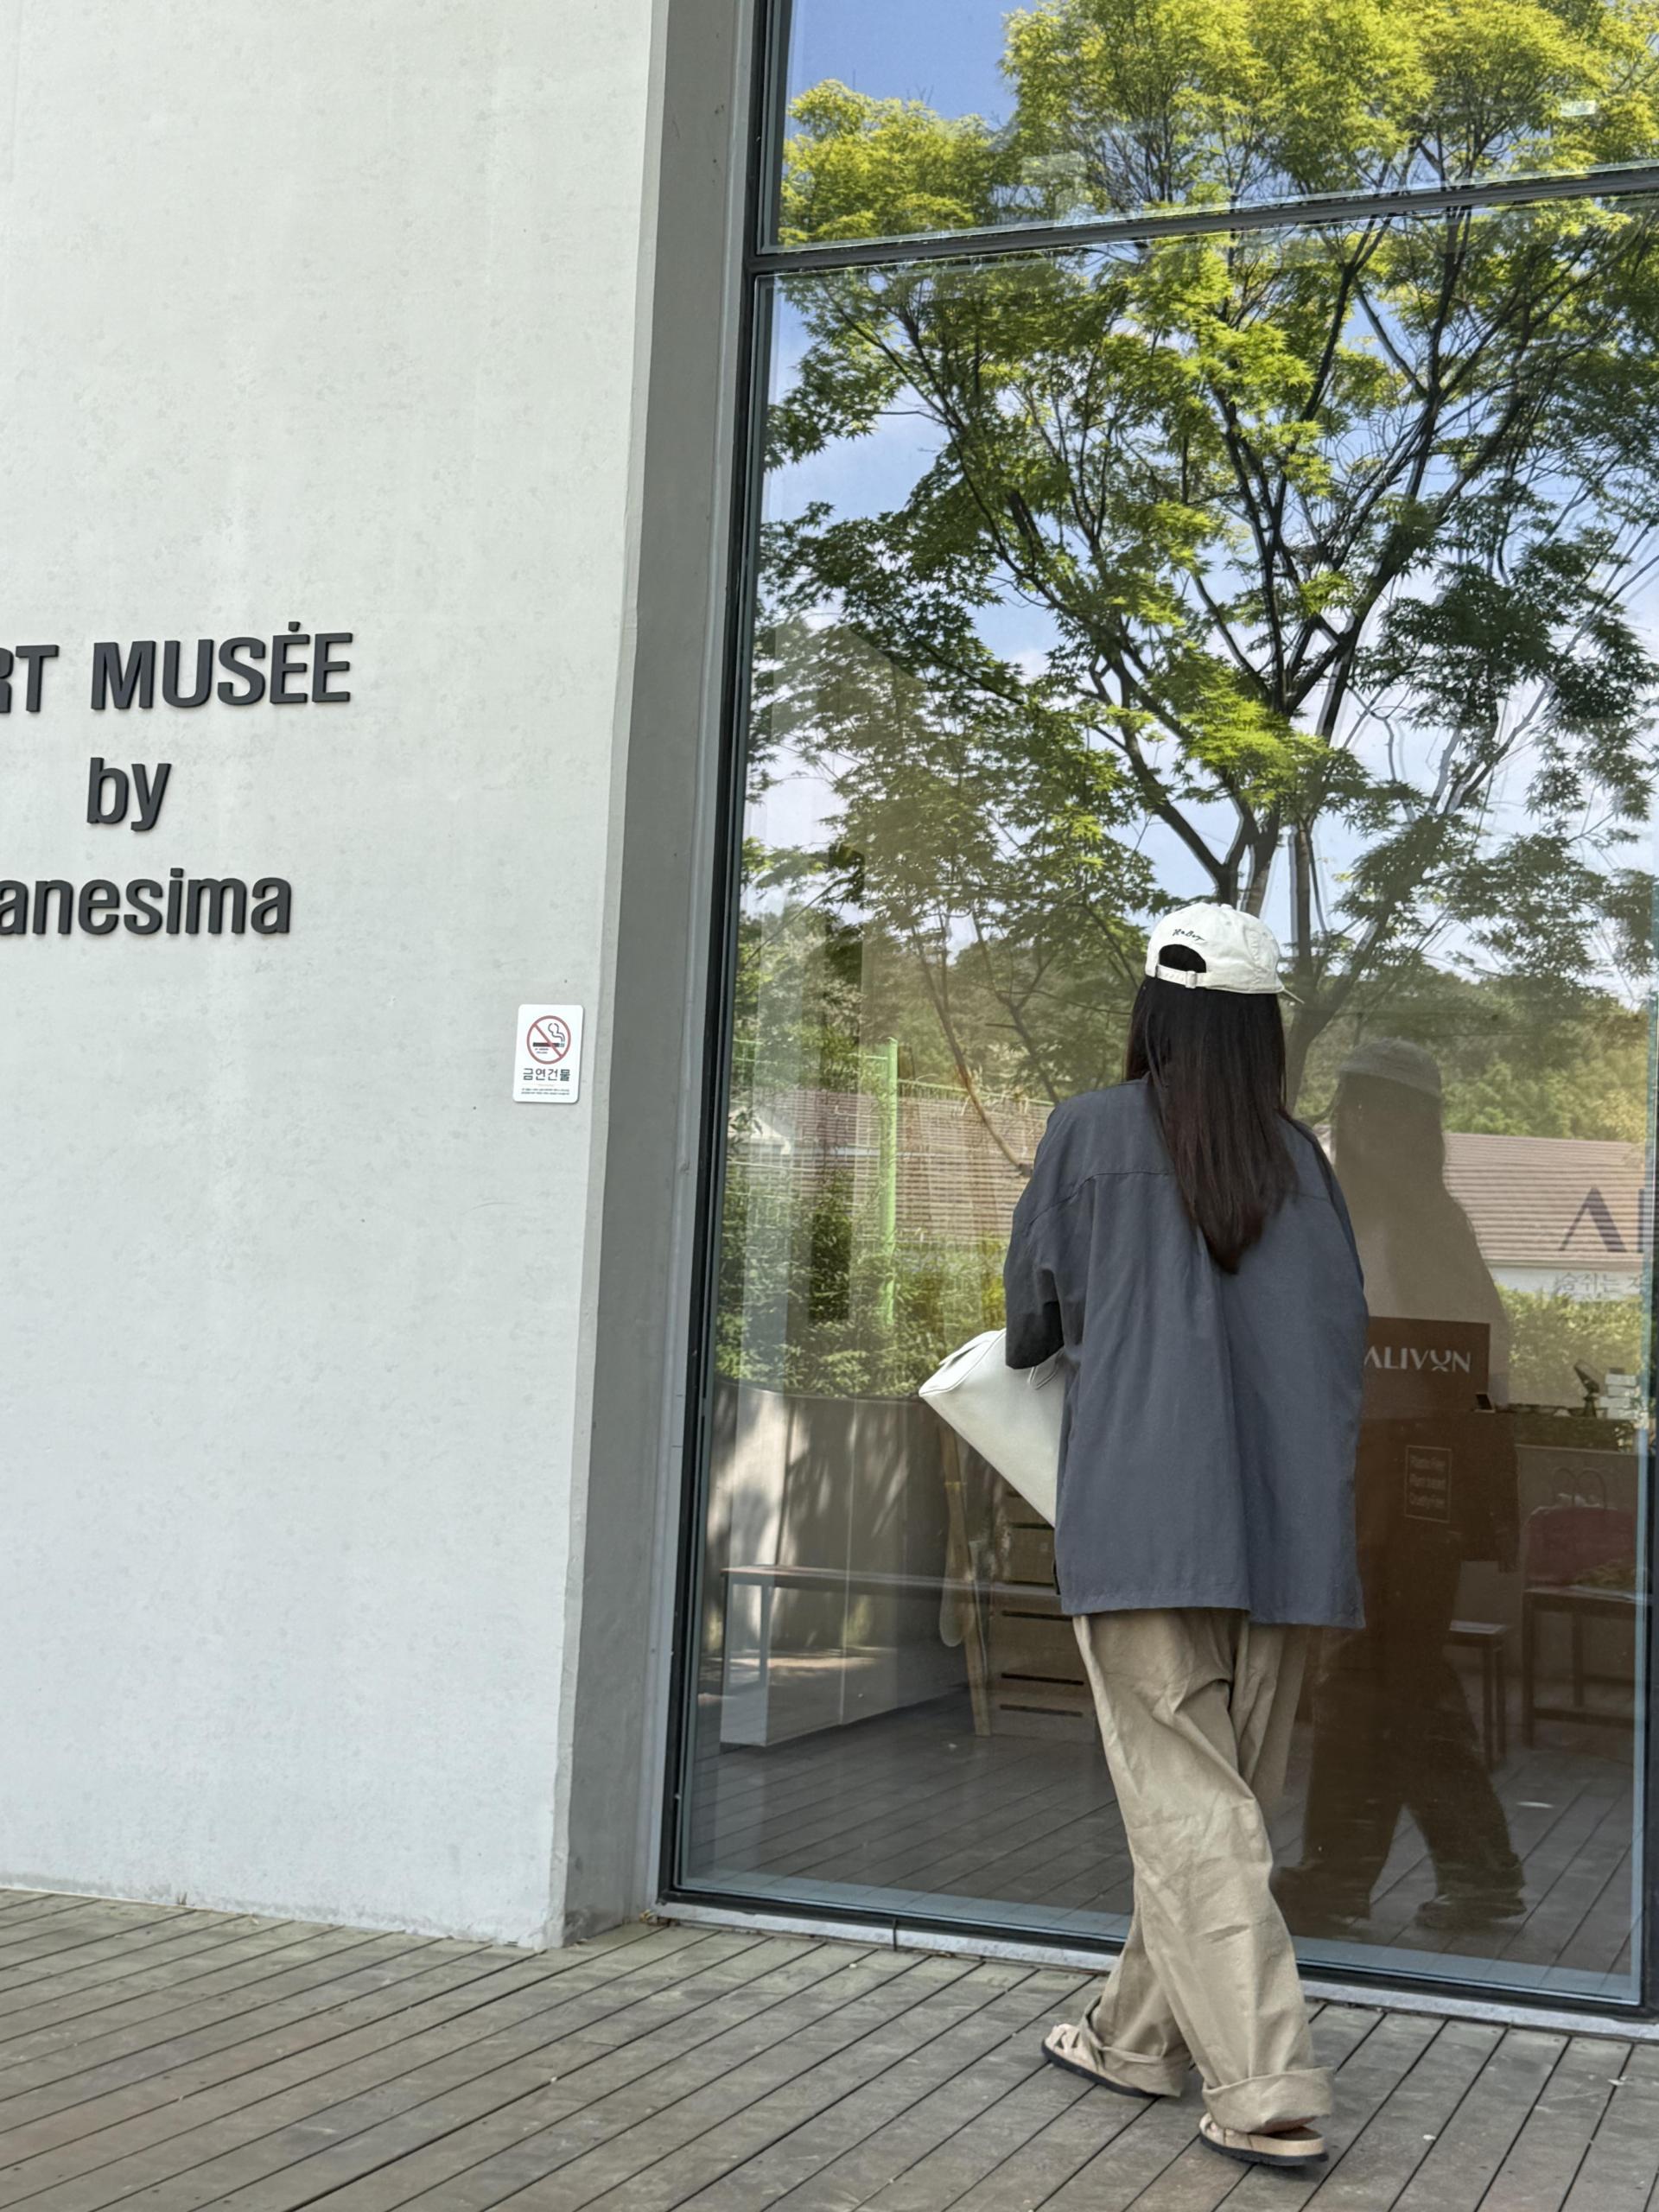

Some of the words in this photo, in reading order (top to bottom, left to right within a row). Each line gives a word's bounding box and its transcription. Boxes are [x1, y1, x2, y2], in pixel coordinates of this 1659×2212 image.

[87, 757, 171, 832] by
[0, 868, 292, 937] anesima
[523, 1068, 570, 1082] 금연건물
